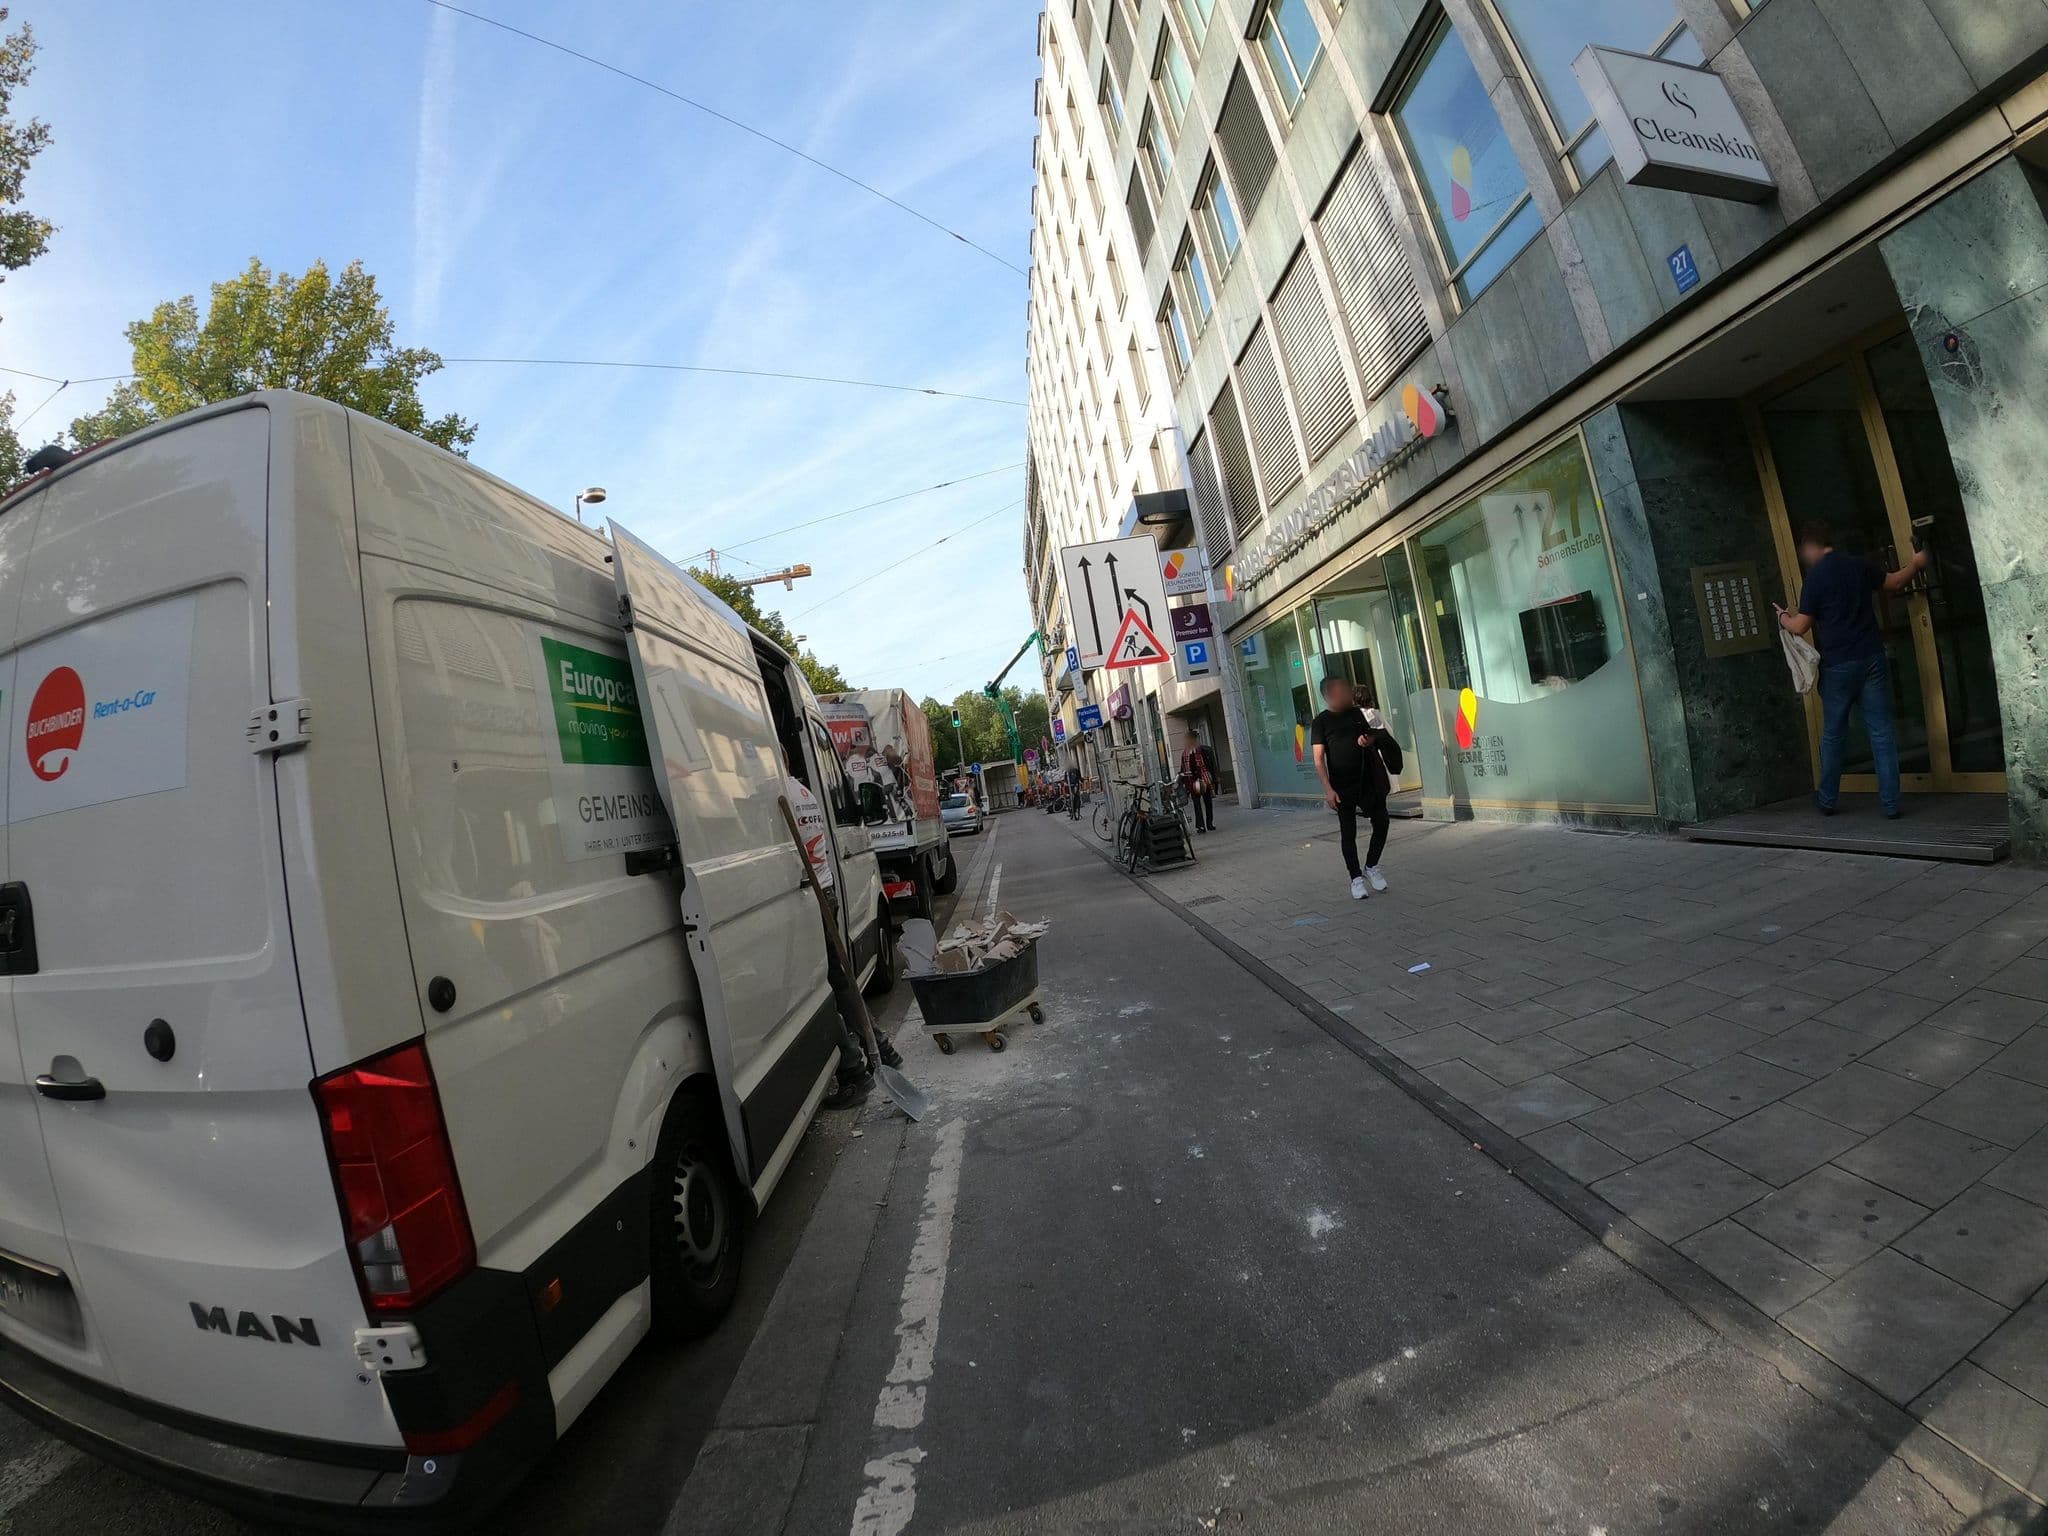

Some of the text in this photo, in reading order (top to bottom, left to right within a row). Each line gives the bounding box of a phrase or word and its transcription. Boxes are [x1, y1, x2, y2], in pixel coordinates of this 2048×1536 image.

[1634, 117, 1761, 161] Cleanskin
[1672, 250, 1687, 275] 27
[1537, 533, 1602, 568] Sonnenstraße
[1176, 627, 1198, 637] Premier
[1189, 644, 1201, 662] P
[560, 659, 637, 712] Europca
[93, 690, 157, 720] Rent-a-Car
[28, 707, 83, 739] BUCHBINDER
[568, 719, 608, 741] moving
[1472, 735, 1505, 749] SONNEN
[578, 793, 664, 823] GEMEINSA
[190, 1301, 321, 1347] MAN
